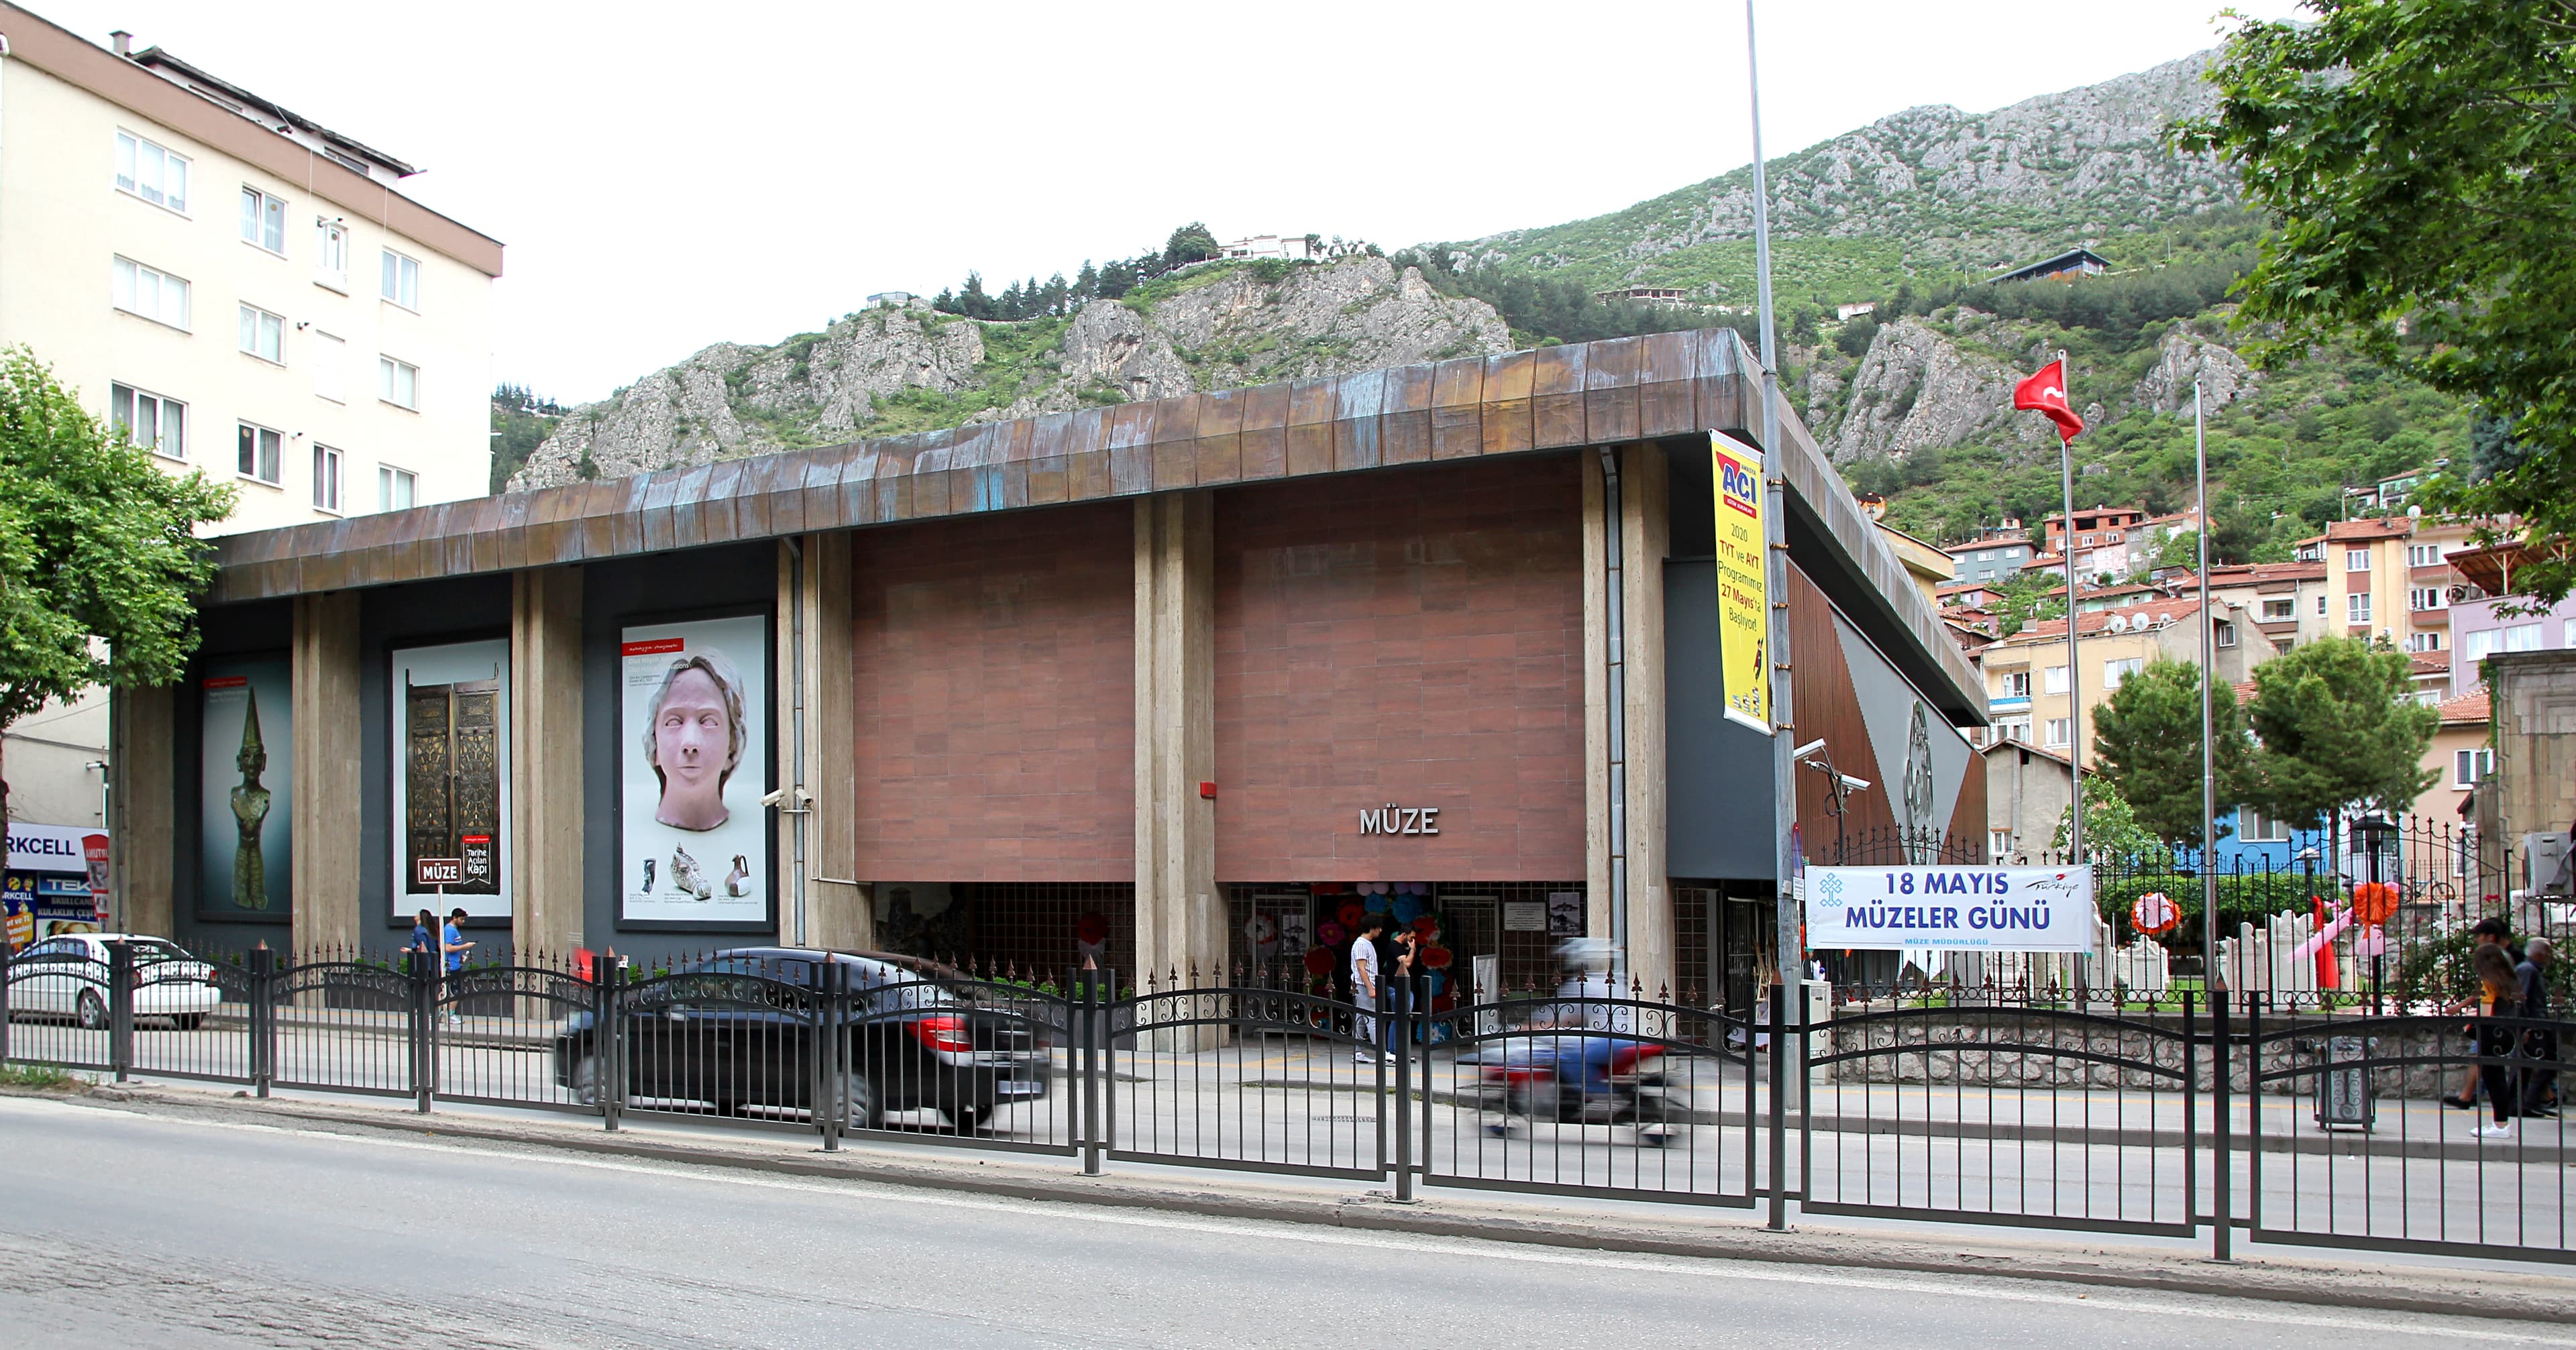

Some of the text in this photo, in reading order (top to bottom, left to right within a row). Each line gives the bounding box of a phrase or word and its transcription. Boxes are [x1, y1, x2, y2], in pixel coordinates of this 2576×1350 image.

[1722, 464, 1757, 505] AÇI
[1731, 523, 1748, 542] 2020
[1719, 539, 1759, 569] TYT ve AYT
[1718, 560, 1762, 593] Programımız
[1721, 583, 1761, 613] 27 Mayıs'ta
[1729, 606, 1757, 632] Başlıyor!
[1360, 802, 1439, 834] MÜZE
[467, 849, 487, 857] Tarihe
[468, 857, 487, 866] Açılan
[423, 862, 458, 880] MÜZE
[467, 864, 487, 877] Kapı
[46, 879, 91, 891] TEK
[1886, 872, 2008, 895] 18 MAYIS
[2025, 879, 2079, 899] Türkiye
[2, 891, 33, 901] RKCELL
[38, 907, 75, 917] KULAKLIK
[1845, 899, 2050, 930] MÜZELER GÜNÜ
